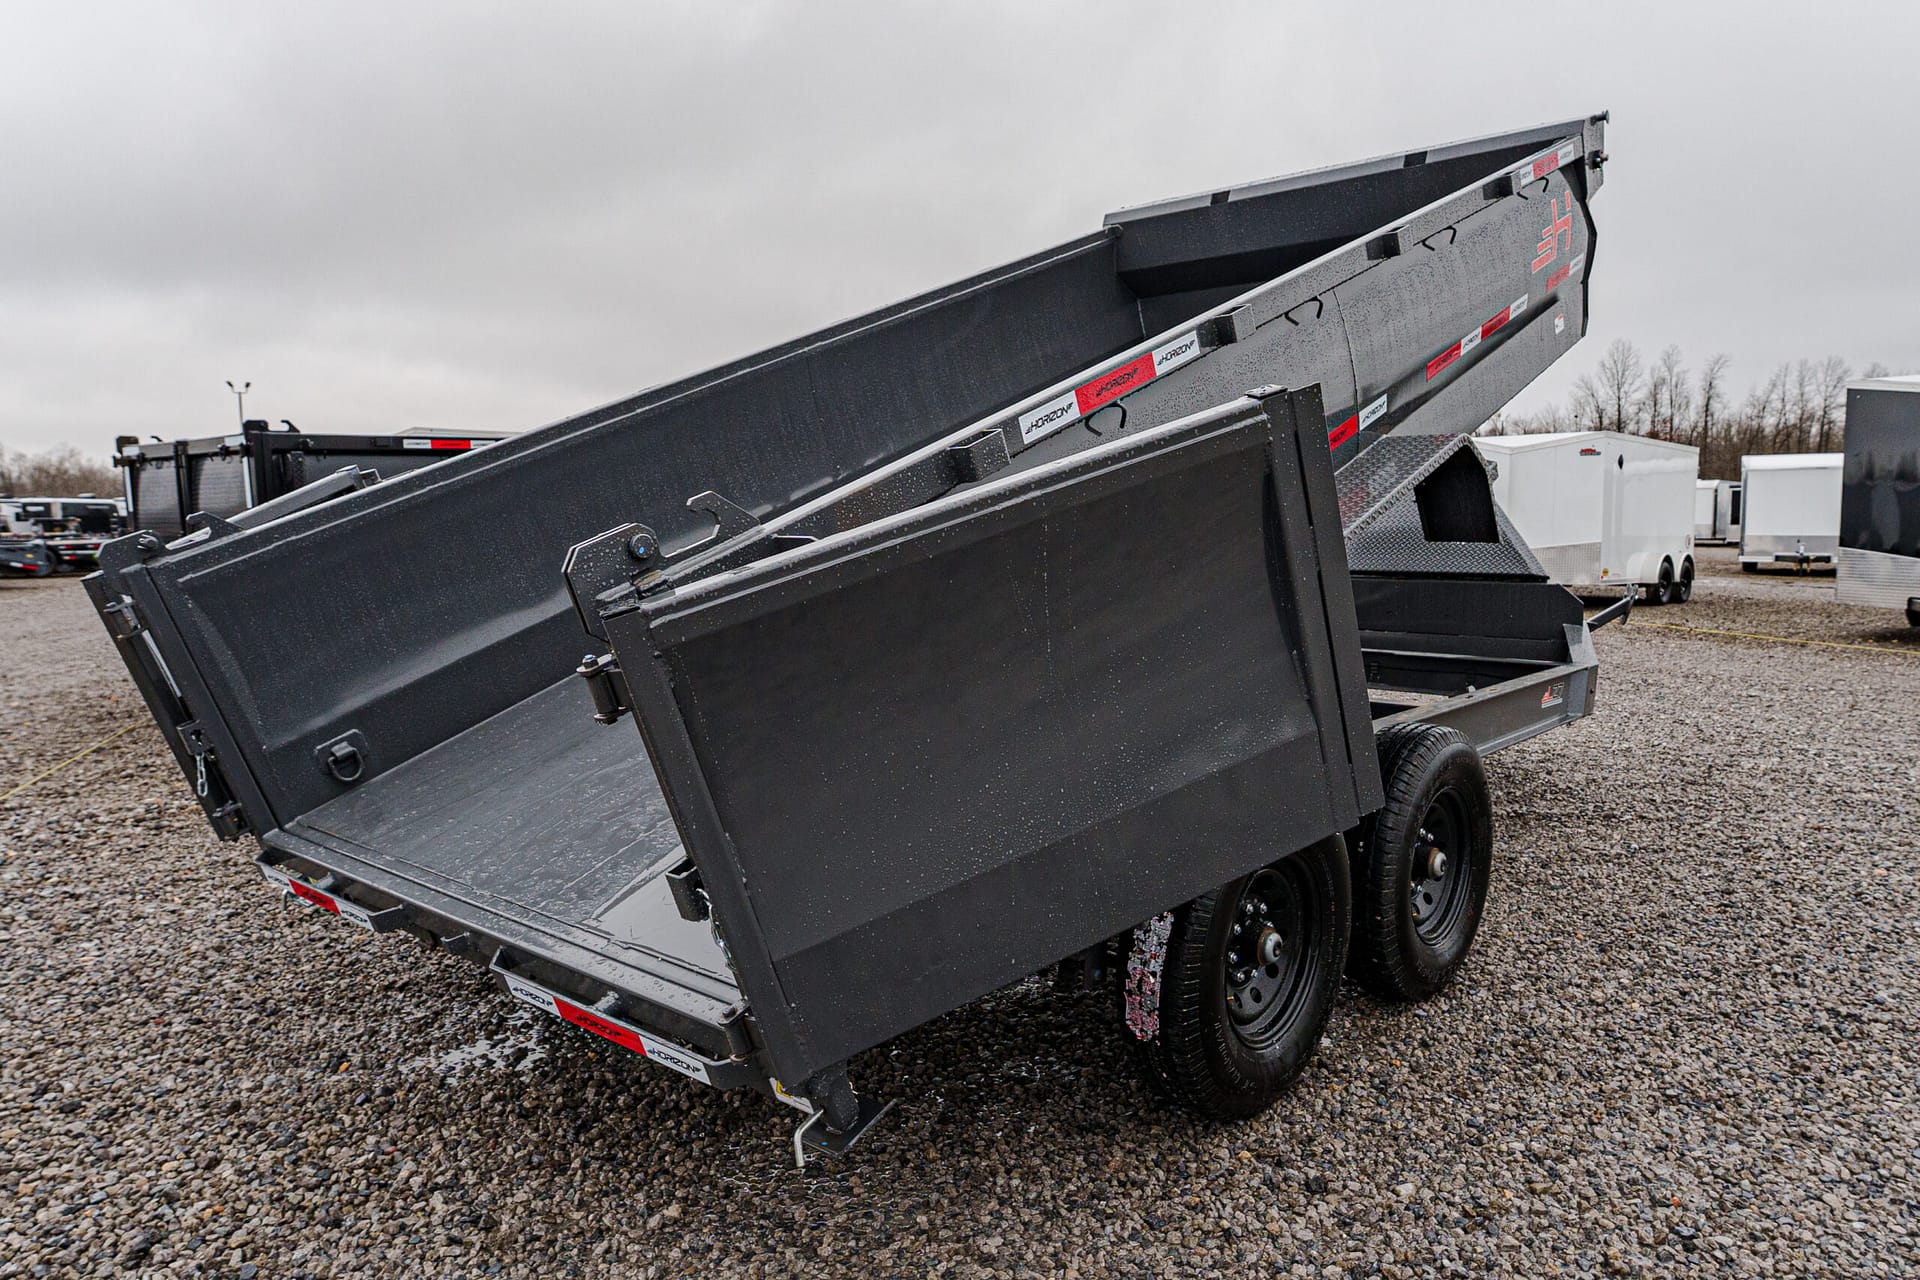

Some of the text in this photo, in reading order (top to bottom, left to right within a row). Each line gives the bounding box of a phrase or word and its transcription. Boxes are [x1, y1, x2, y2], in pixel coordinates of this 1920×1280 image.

[1159, 341, 1194, 365] HORIZON
[1098, 369, 1137, 396] HORIZON
[1027, 404, 1072, 433] HORIZON
[649, 1048, 700, 1073] HORIZON
